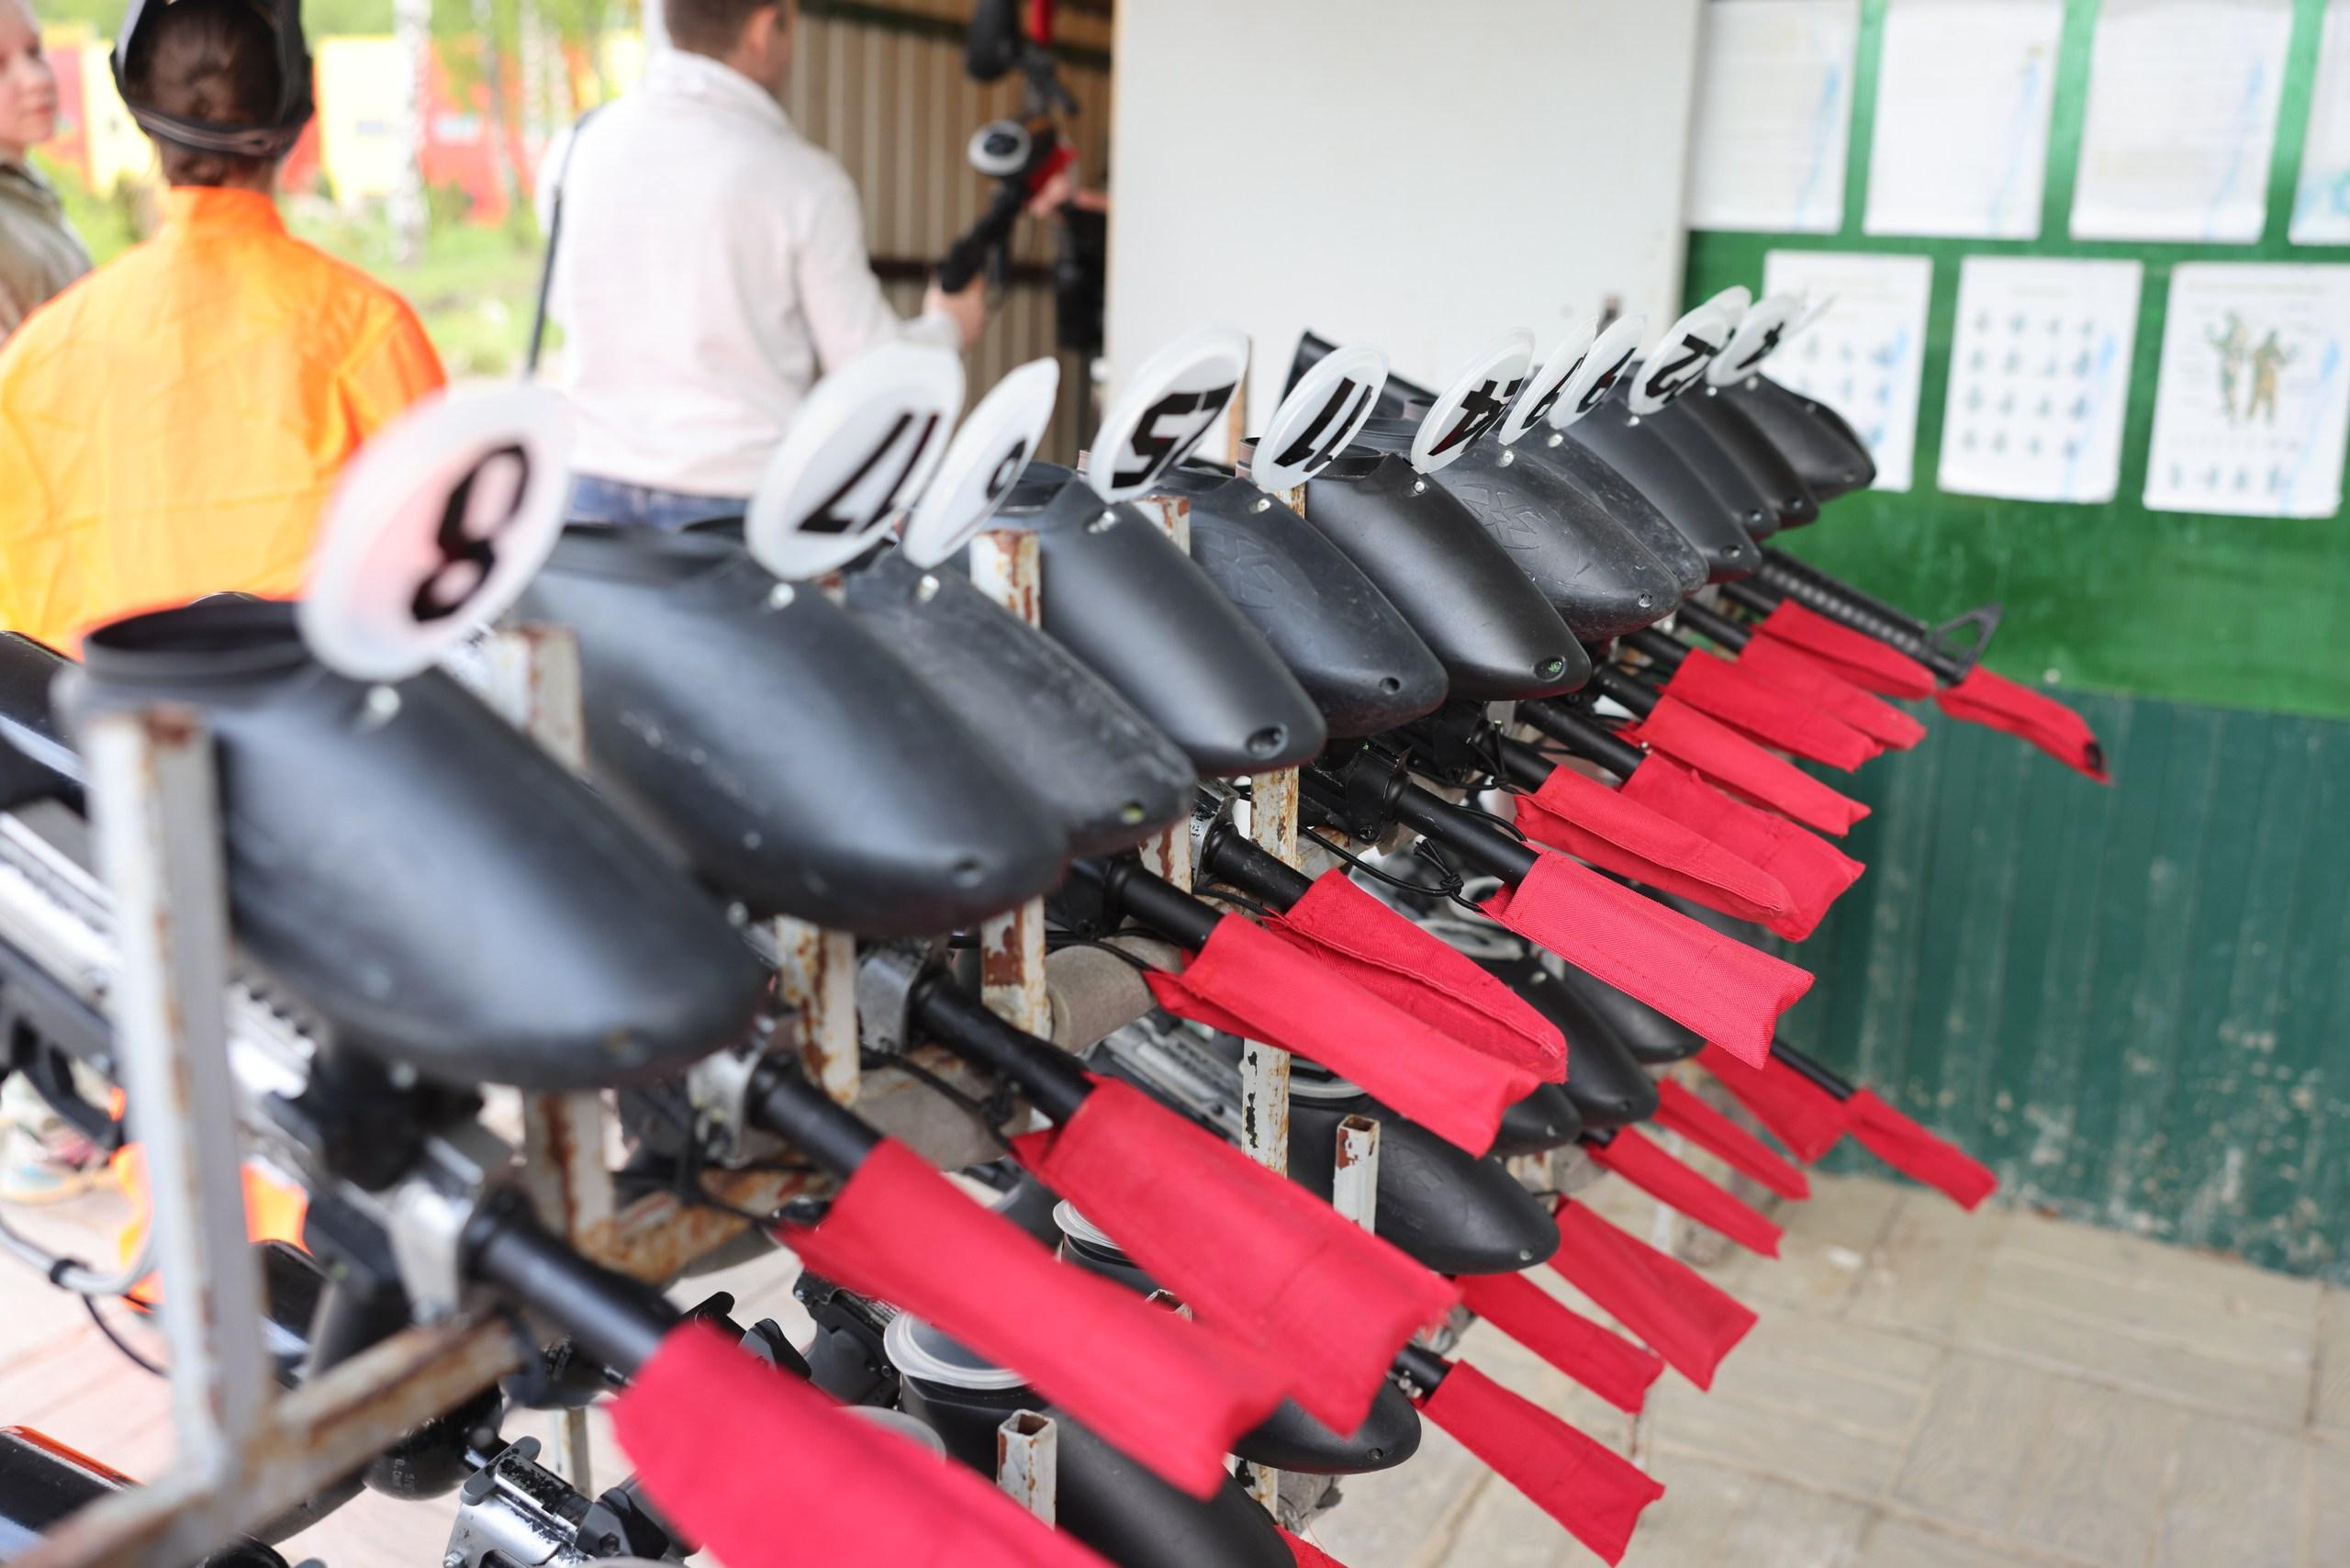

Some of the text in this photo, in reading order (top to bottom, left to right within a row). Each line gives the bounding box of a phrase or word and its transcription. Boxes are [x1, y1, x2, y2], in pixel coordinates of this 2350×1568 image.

[797, 410, 940, 532] 17
[1273, 376, 1374, 474] 11
[409, 442, 531, 622] 8
